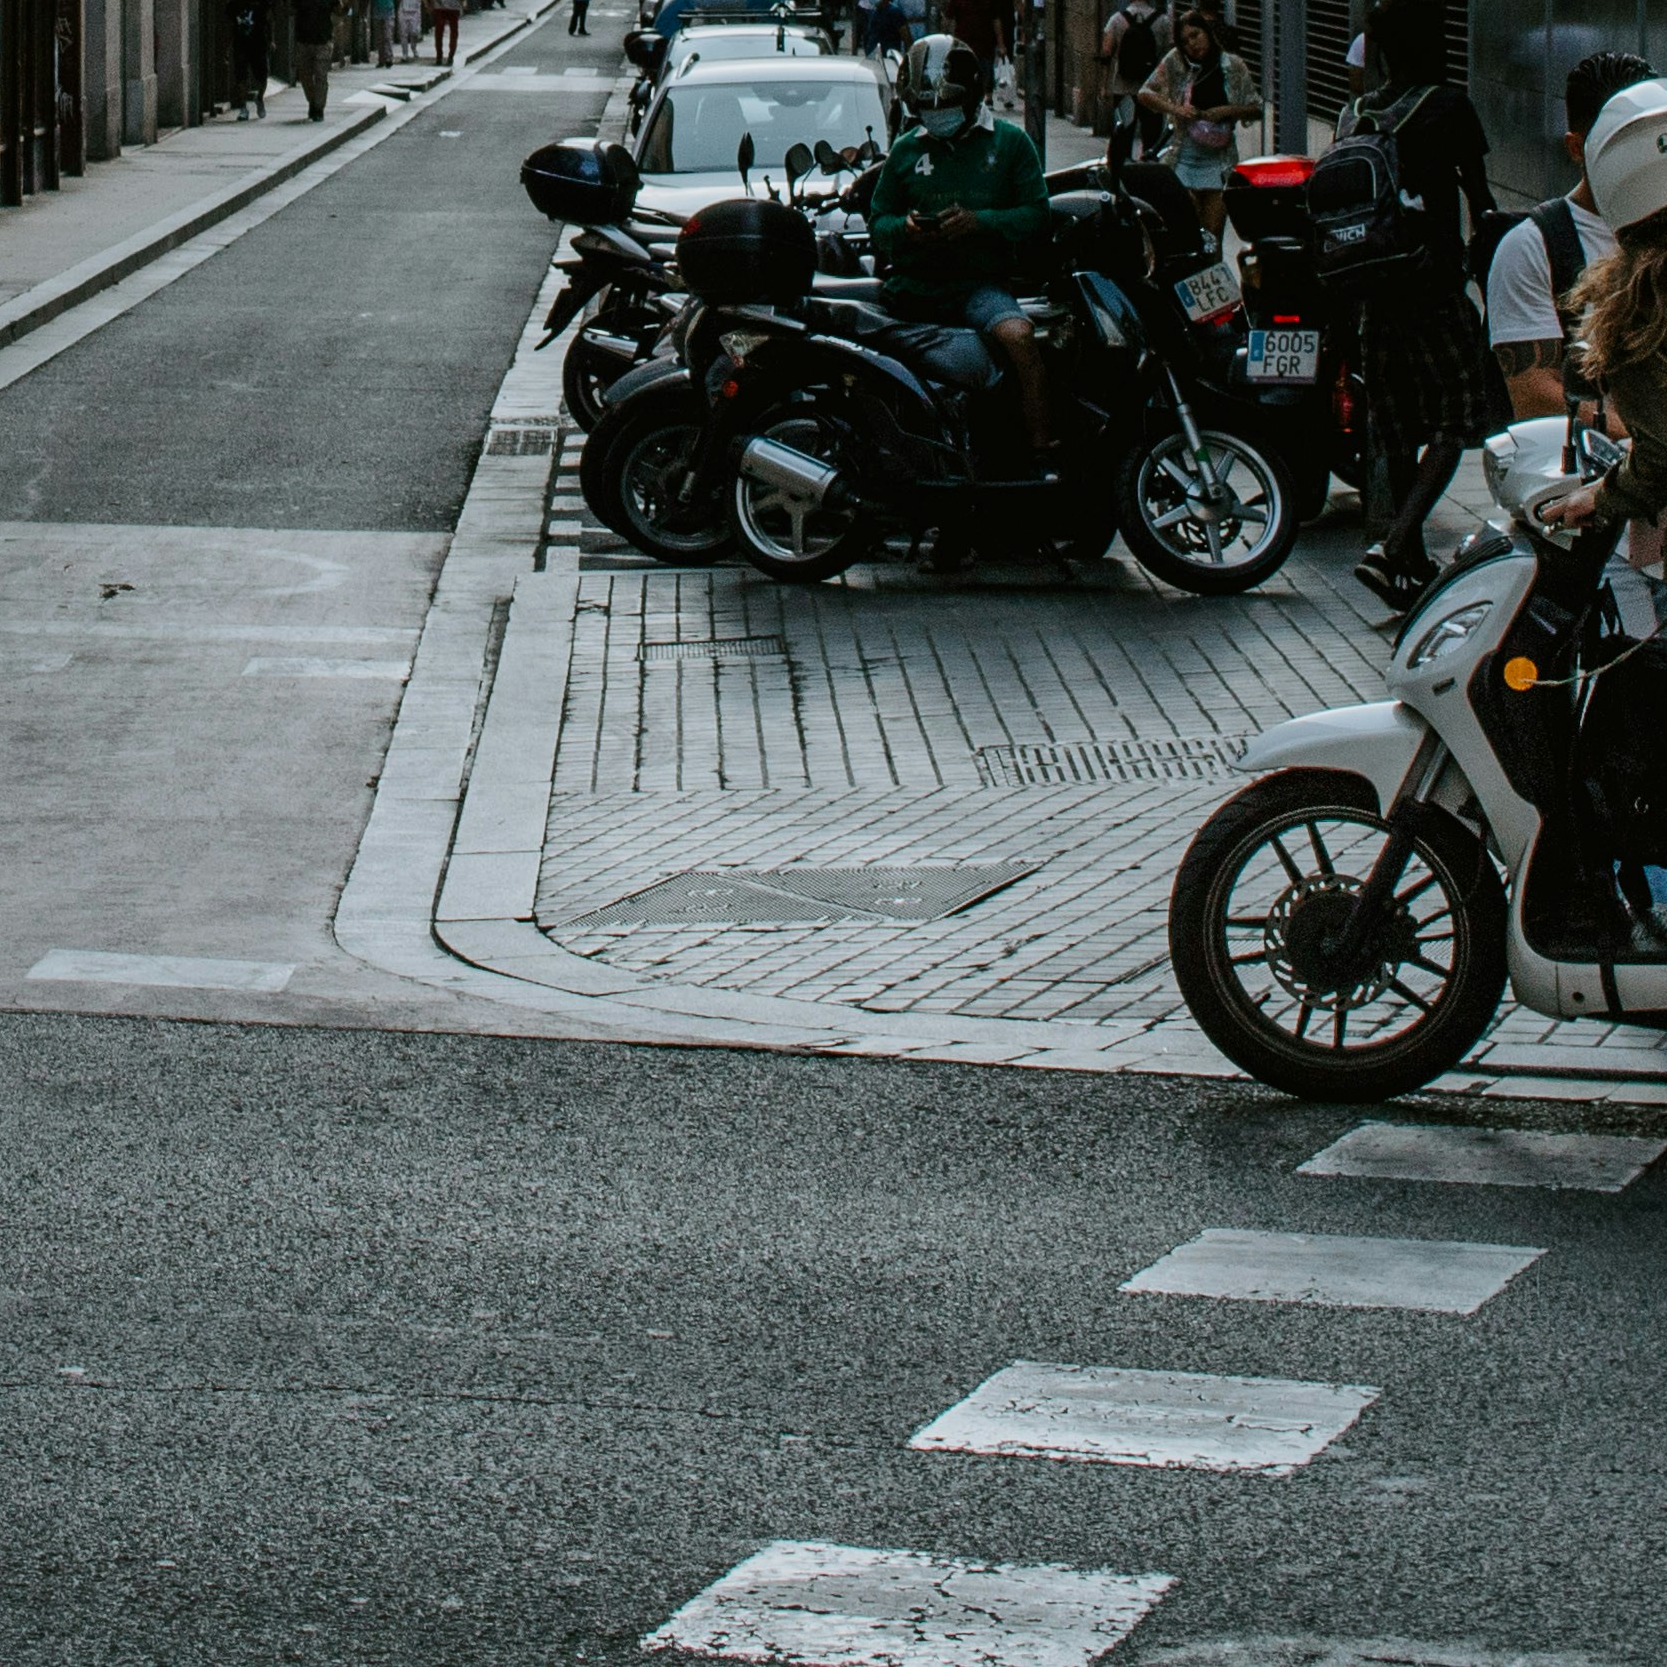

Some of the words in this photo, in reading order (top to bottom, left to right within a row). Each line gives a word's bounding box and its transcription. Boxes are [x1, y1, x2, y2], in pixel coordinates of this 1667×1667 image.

[915, 153, 934, 176] 4
[1197, 287, 1230, 313] LFC
[1265, 333, 1315, 354] 6005
[1263, 355, 1301, 375] FGR
